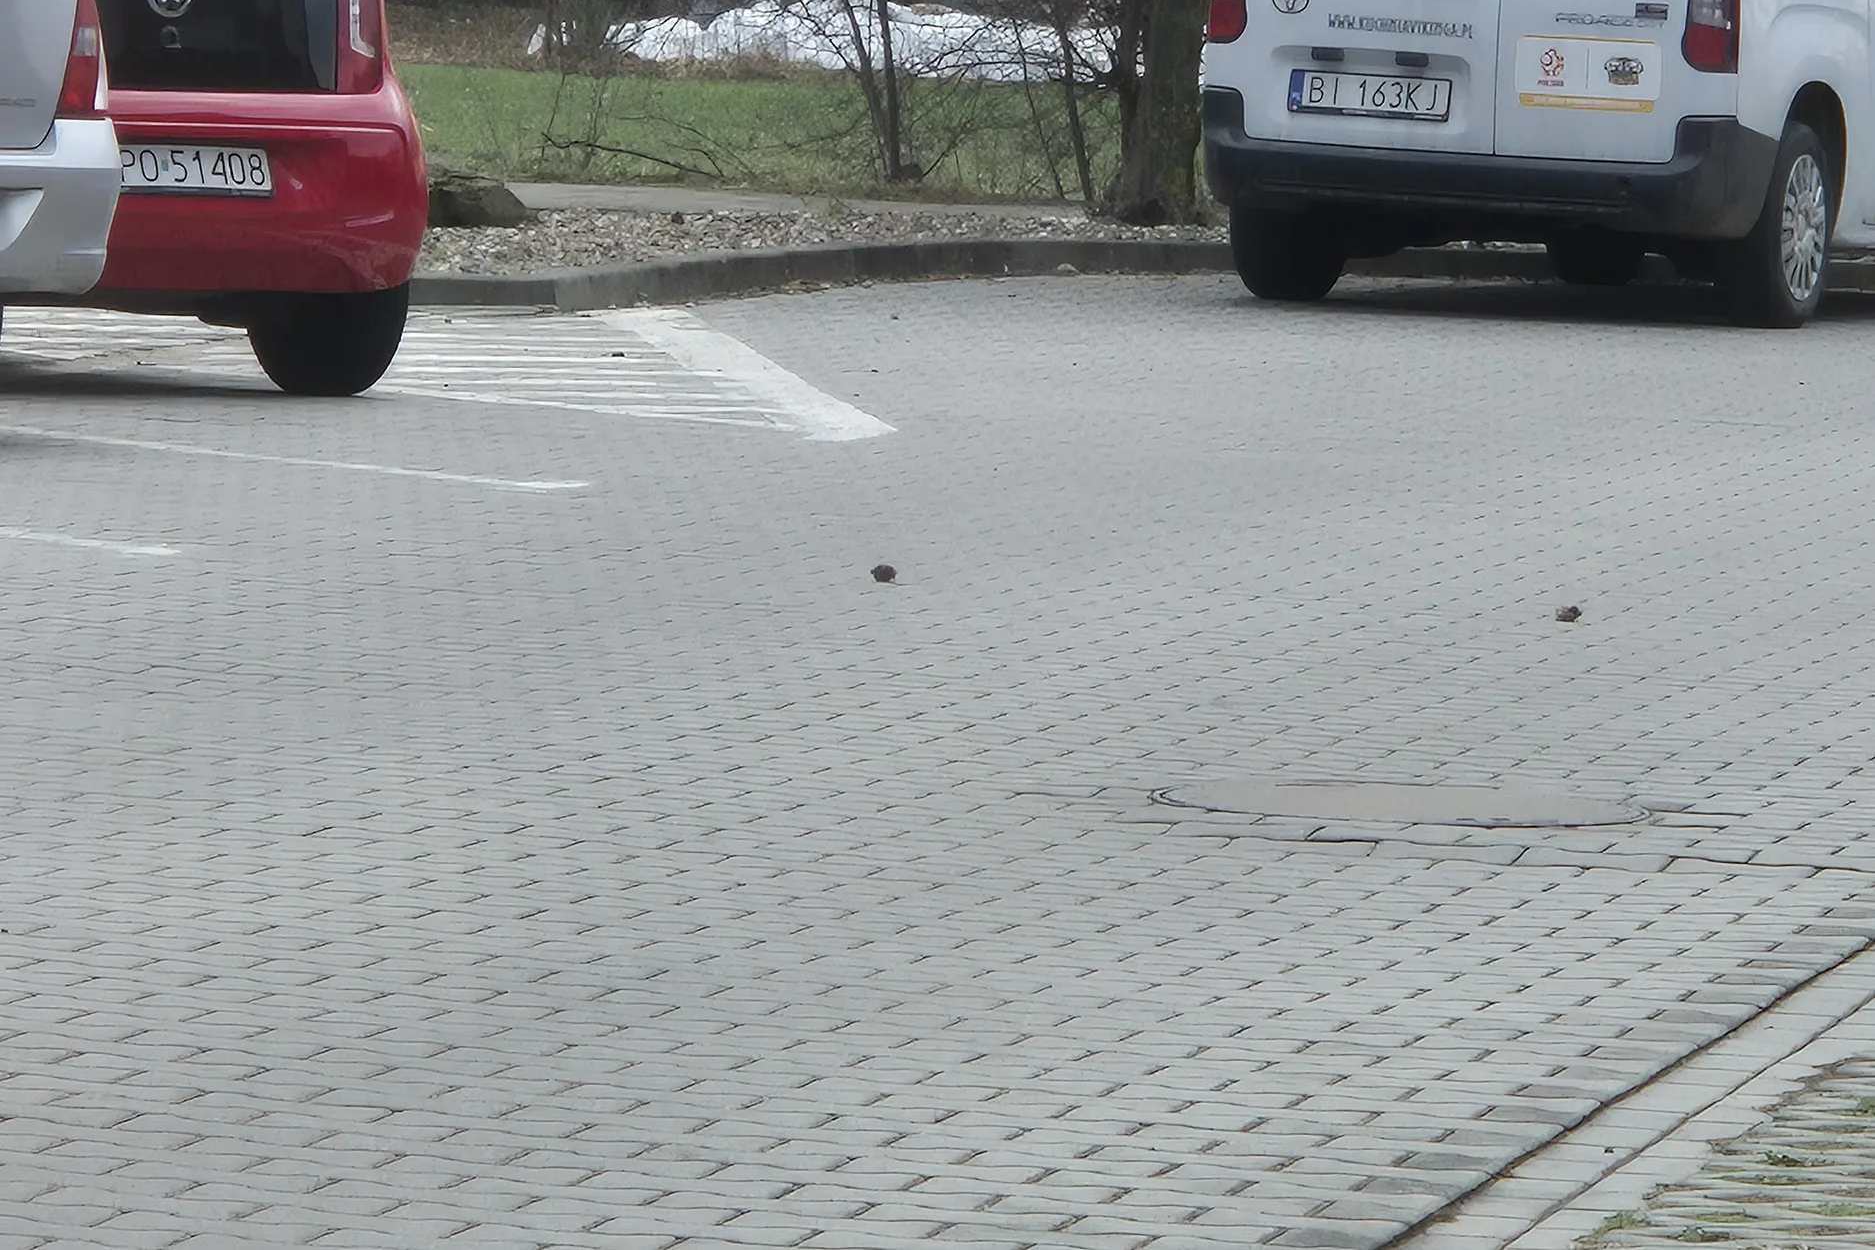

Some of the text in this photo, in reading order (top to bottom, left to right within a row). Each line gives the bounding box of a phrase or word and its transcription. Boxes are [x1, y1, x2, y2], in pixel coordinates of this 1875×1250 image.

[1309, 76, 1438, 111] BI 163KJ
[120, 149, 266, 185] PO 51408
